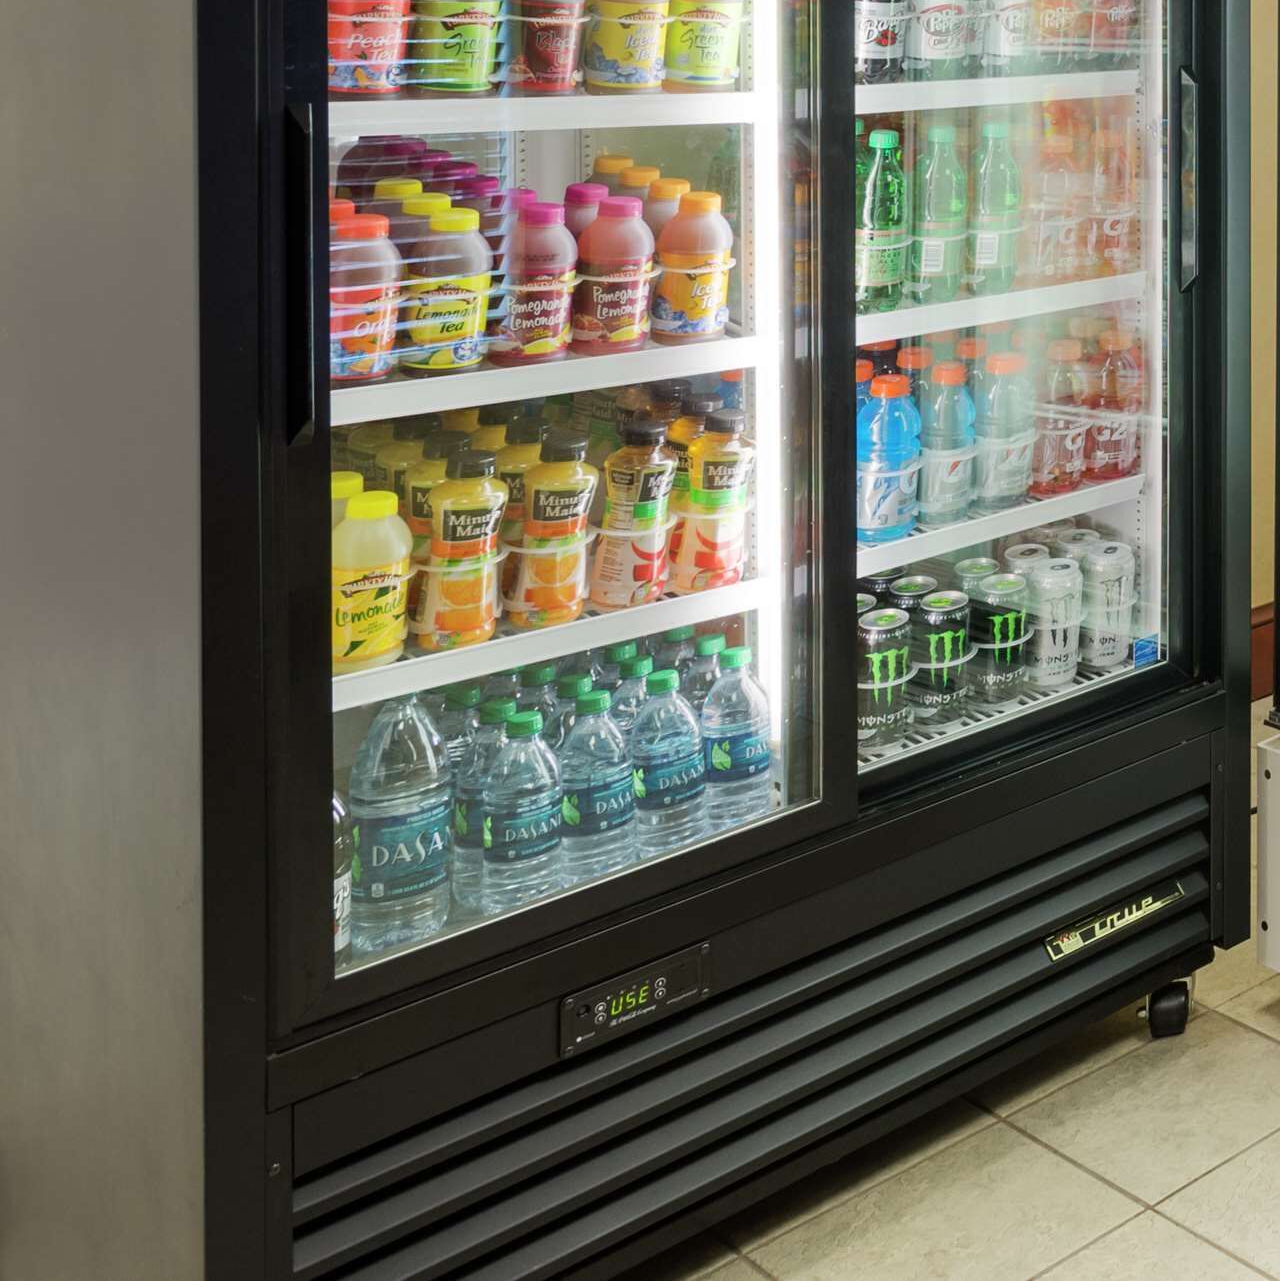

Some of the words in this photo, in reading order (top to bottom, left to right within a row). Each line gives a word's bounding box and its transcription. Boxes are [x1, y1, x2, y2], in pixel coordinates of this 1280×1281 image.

[440, 321, 464, 333] Tea
[371, 826, 451, 867] DASA
[611, 985, 649, 1015] USE
